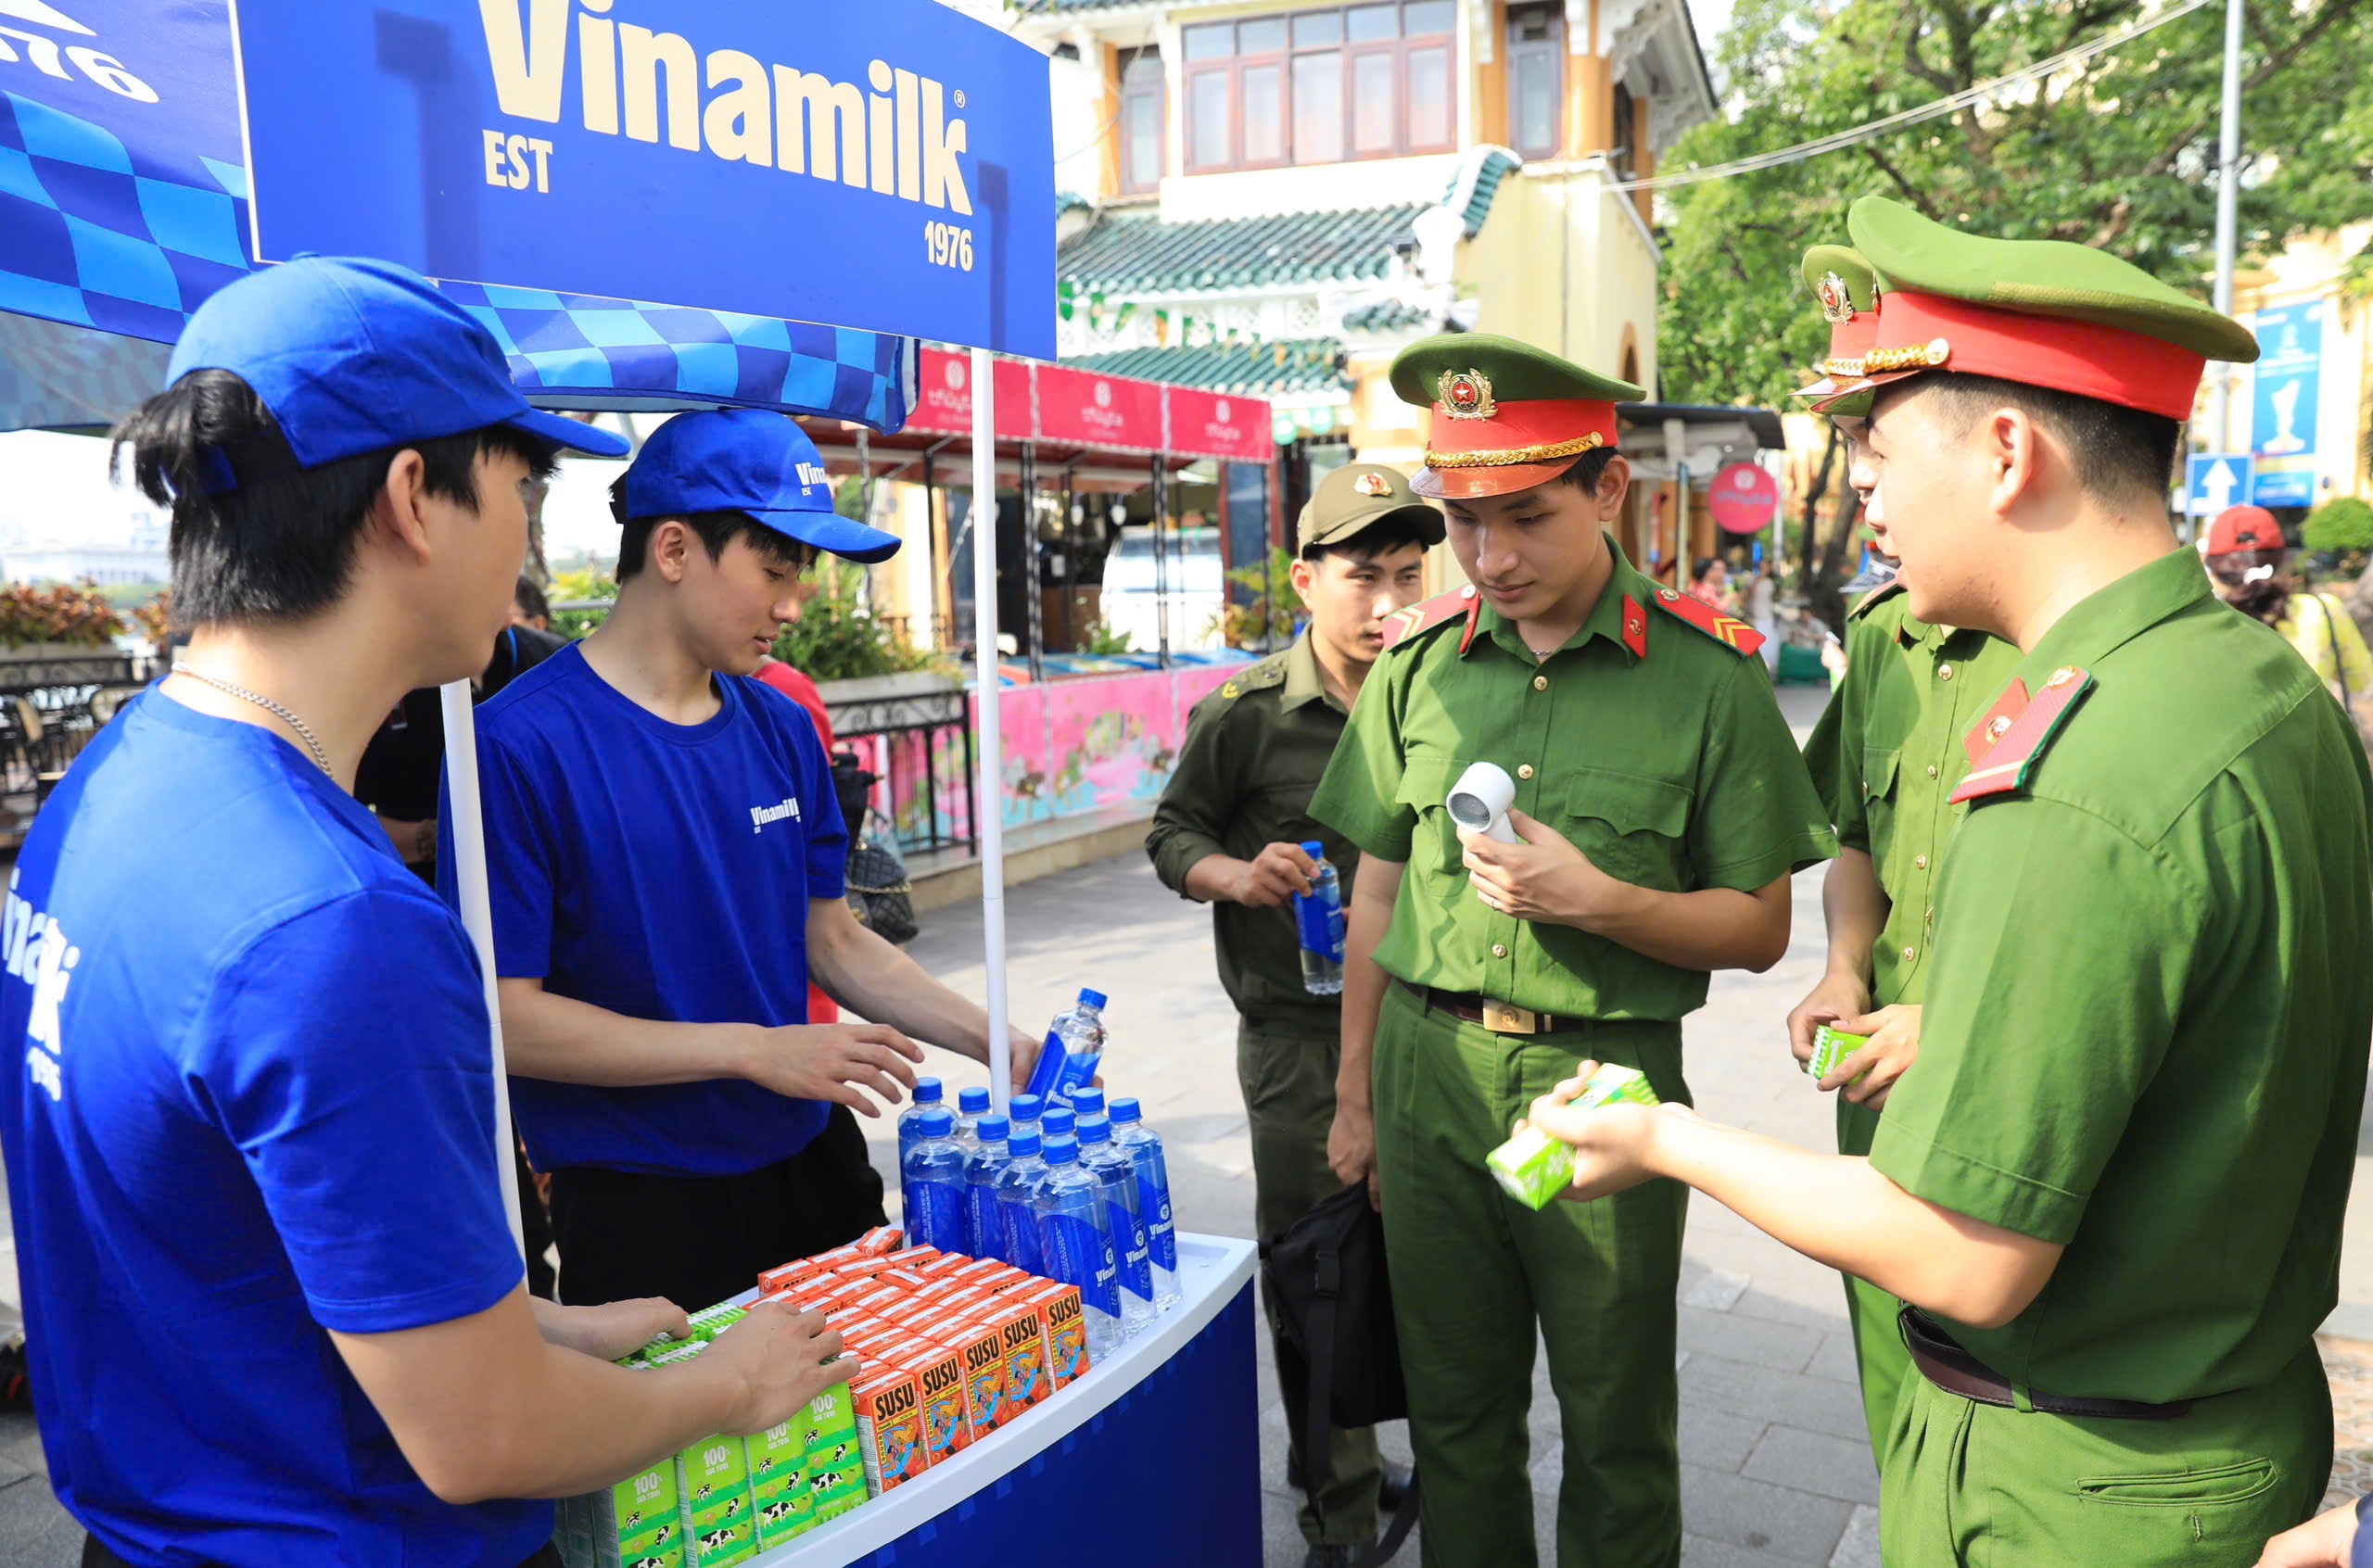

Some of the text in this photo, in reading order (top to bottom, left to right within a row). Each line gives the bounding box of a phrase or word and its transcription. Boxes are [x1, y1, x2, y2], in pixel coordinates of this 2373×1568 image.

[0, 25, 159, 103] 76
[483, 130, 553, 194] EST
[925, 220, 972, 272] 1976
[1048, 1293, 1080, 1327] SUSU
[1004, 1313, 1039, 1349] SUSU
[966, 1335, 1000, 1372] SUSU
[922, 1358, 958, 1397] SUSU
[875, 1382, 915, 1422] SUSU
